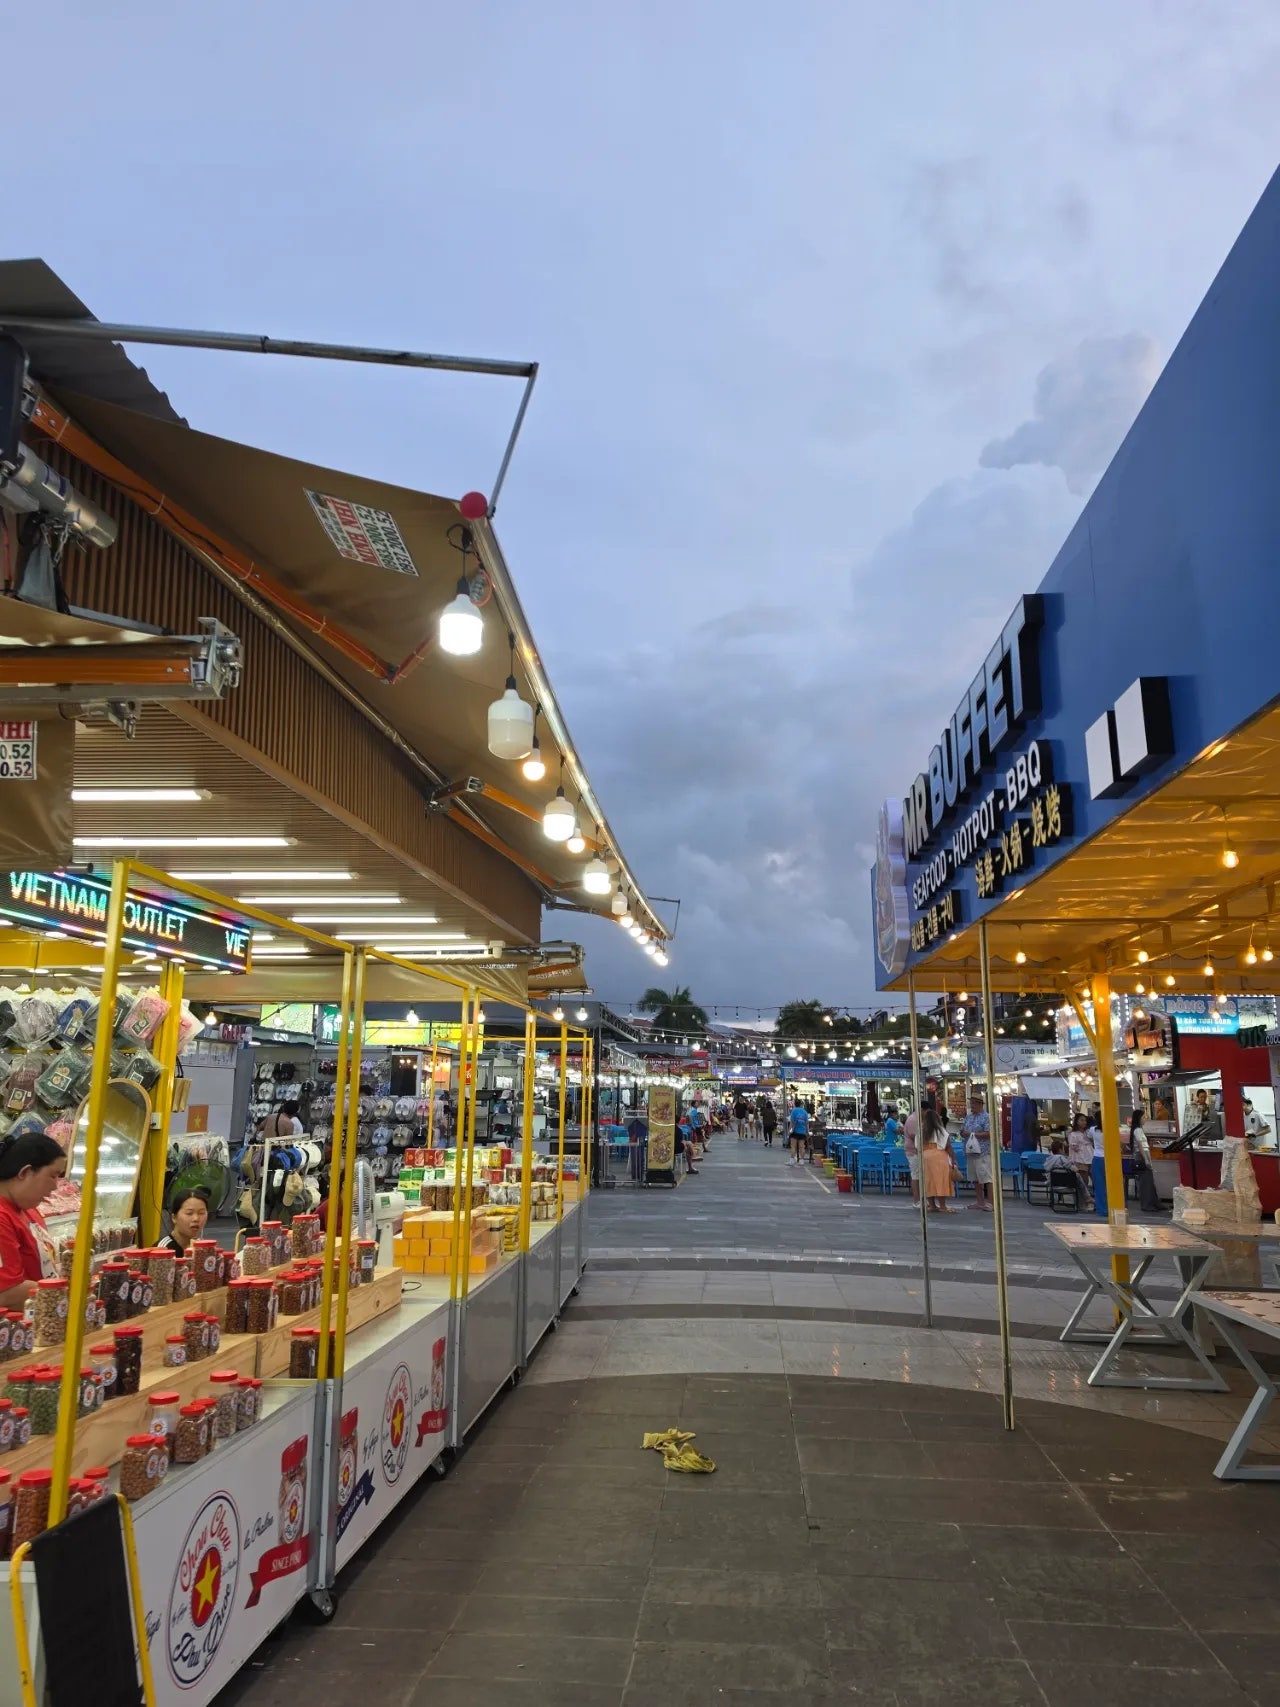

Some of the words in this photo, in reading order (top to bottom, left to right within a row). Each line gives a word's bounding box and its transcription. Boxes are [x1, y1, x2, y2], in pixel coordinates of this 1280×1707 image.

[902, 773, 928, 864] MR
[928, 593, 1026, 829] BUFFET
[10, 871, 107, 922] VIETNAM
[122, 901, 188, 942] OUTLET
[912, 849, 948, 910] SEAFOOD
[952, 789, 995, 868] HOTPOT
[1006, 740, 1042, 813] BBQ
